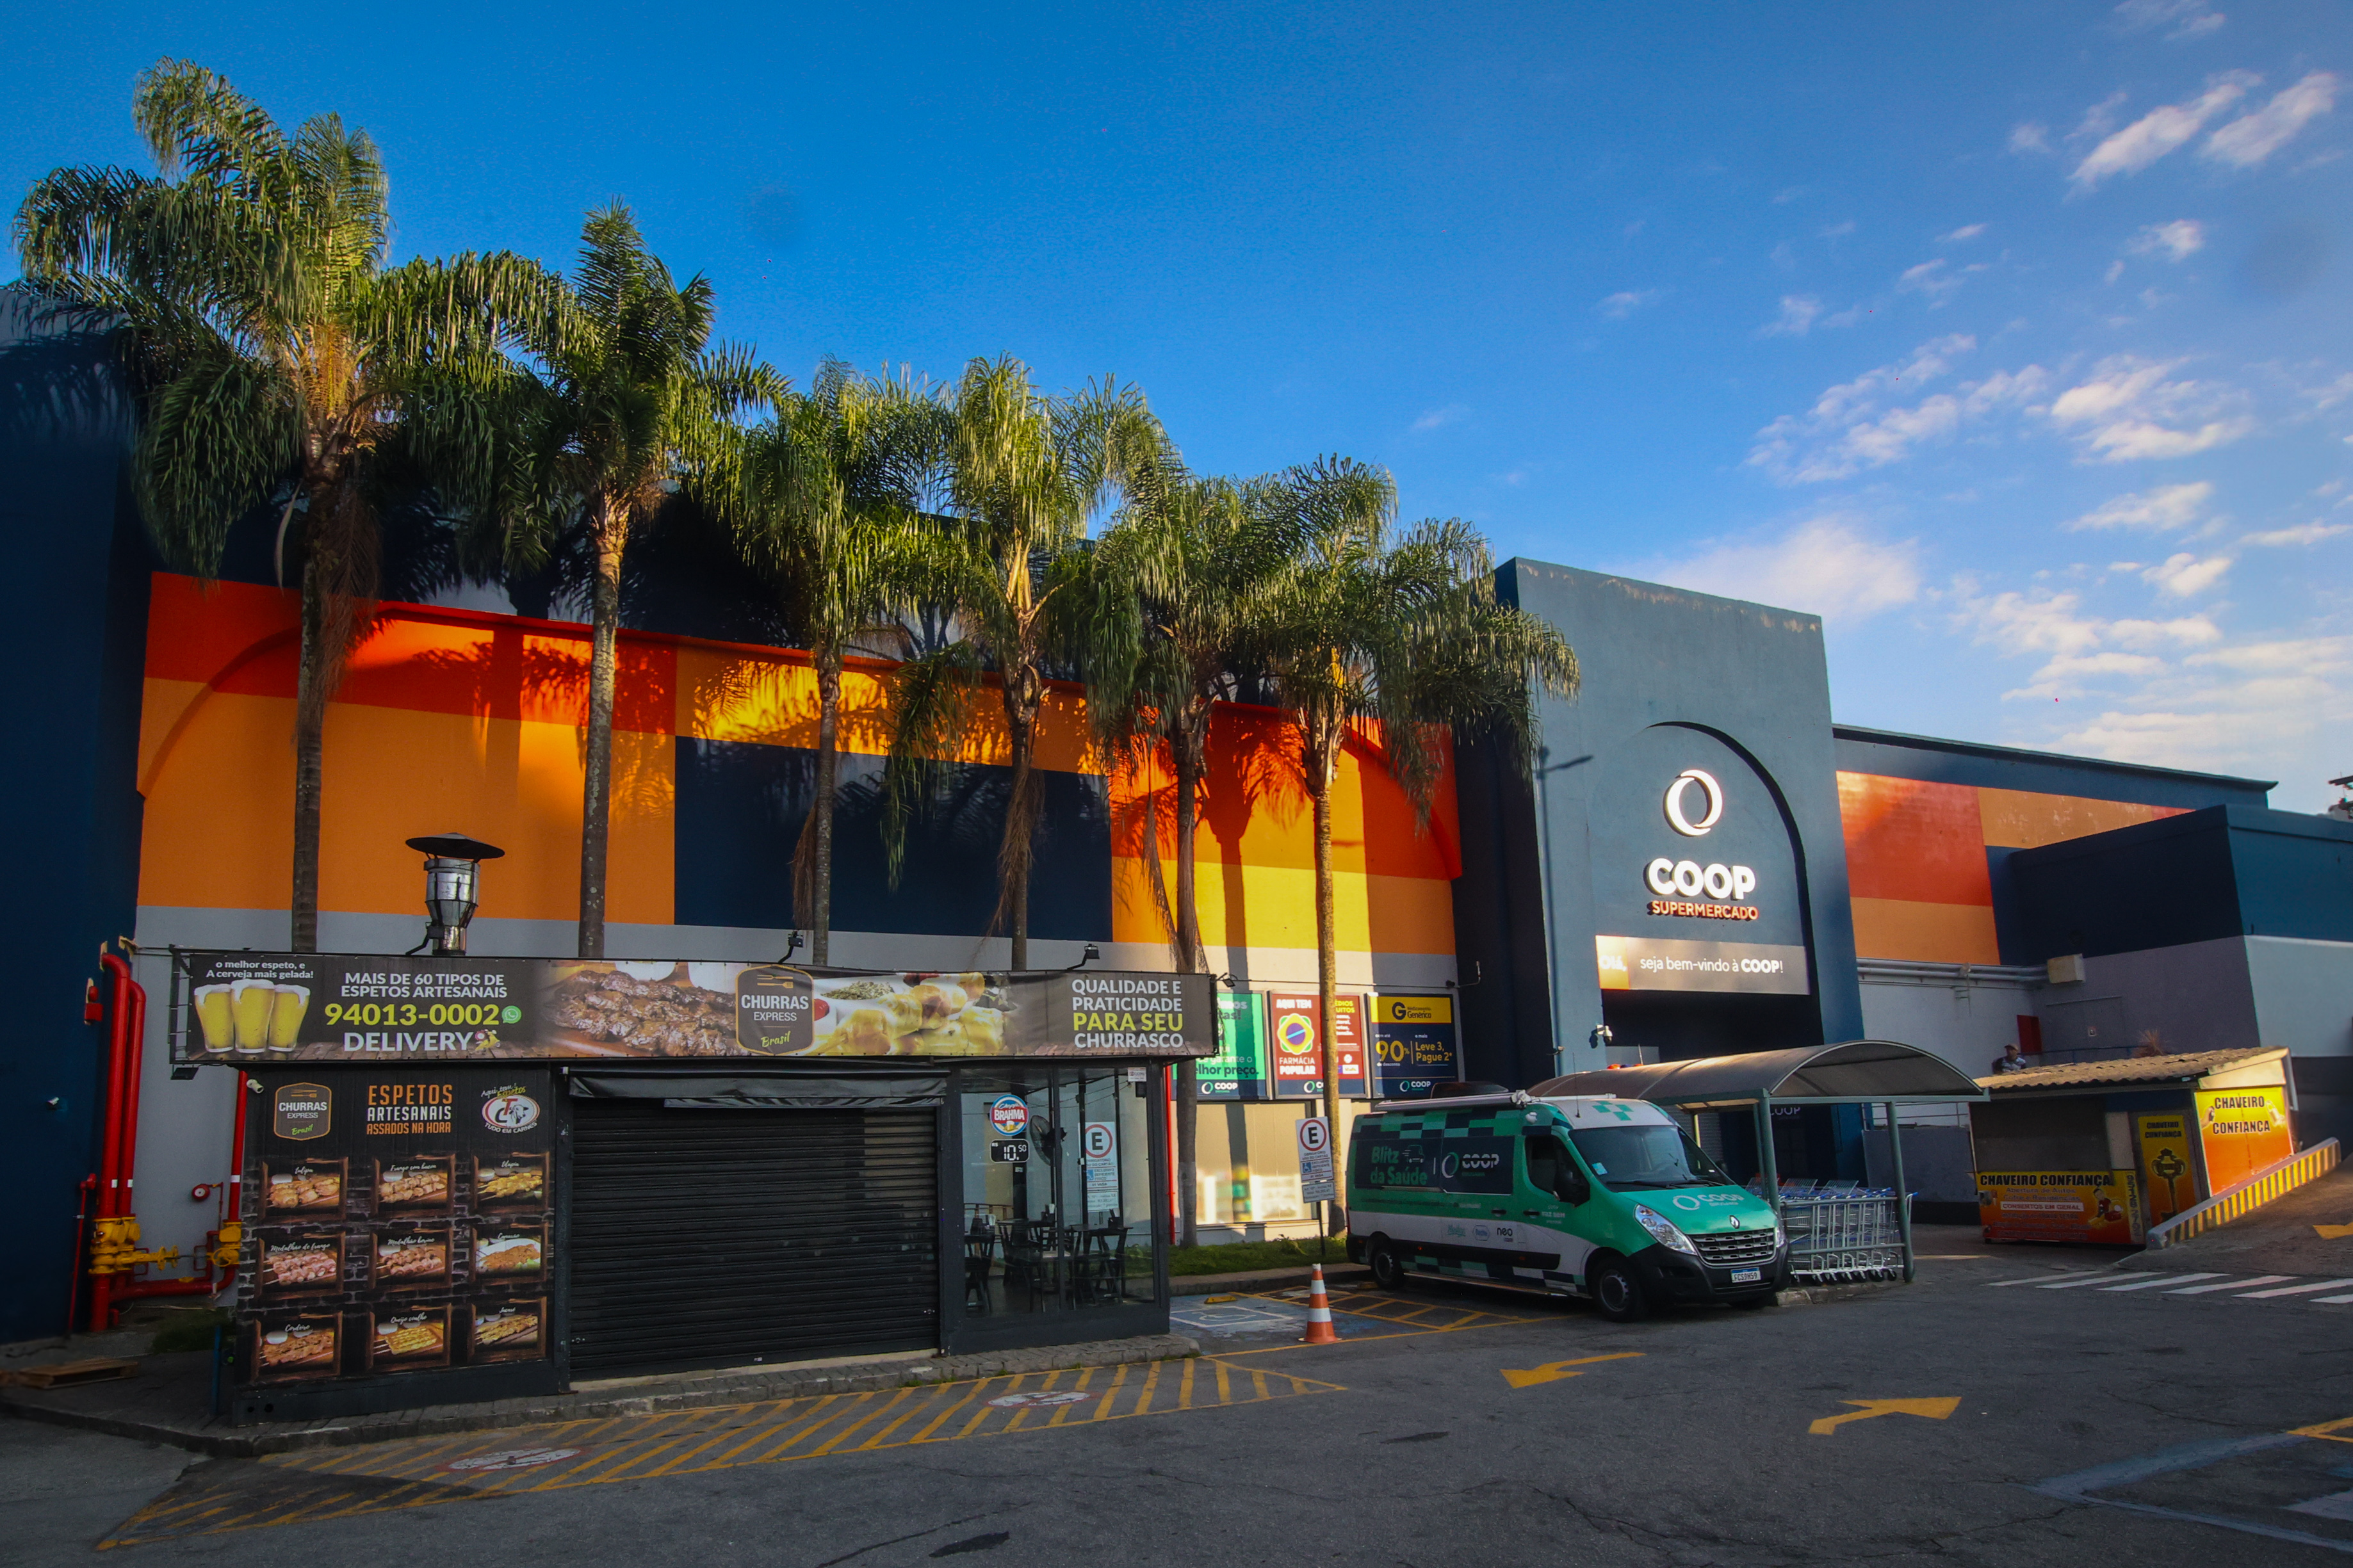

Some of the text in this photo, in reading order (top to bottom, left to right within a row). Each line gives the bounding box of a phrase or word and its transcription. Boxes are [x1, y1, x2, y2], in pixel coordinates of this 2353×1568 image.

[1647, 858, 1755, 900] COOP
[1650, 900, 1759, 920] SUPERMERCADO
[261, 962, 297, 971] espeto,
[1640, 956, 1664, 973] seja
[1666, 957, 1729, 972] bem-vindo
[1732, 958, 1739, 972] à
[1741, 958, 1783, 973] COOP!
[216, 970, 252, 980] cerveja
[254, 970, 277, 978] mais
[279, 970, 313, 980] gelada!
[345, 973, 505, 985] MAIS DE 60 TIPOS DE
[341, 985, 507, 998] ESPETOS ARTESANAIS
[1071, 979, 1182, 995] QUALIDADE E
[741, 994, 809, 1010] CHURRAS
[1072, 997, 1182, 1012] PRATICIDADE
[1276, 999, 1312, 1009] AQUI TEM
[325, 1003, 500, 1026] 94013-0002
[754, 1012, 797, 1021] EXPRESS
[1408, 1010, 1431, 1019] Genérico
[1073, 1012, 1183, 1031] PARA SEU
[344, 1031, 474, 1051] DELIVERY
[761, 1030, 791, 1047] Brasil
[1074, 1033, 1184, 1048] CHURRASCO
[1415, 1042, 1444, 1051] Leve 3,
[1279, 1056, 1315, 1064] FARMÁCIA
[1416, 1053, 1442, 1063] Pague
[1224, 1067, 1258, 1078] preço.
[1280, 1065, 1315, 1075] POPULAR
[368, 1084, 453, 1105] ESPETOS
[279, 1101, 327, 1111] CHURRAS
[2215, 1096, 2265, 1109] CHAVEIRO
[367, 1106, 452, 1122] ARTESANAIS
[994, 1110, 1025, 1120] BRAHMA
[291, 1124, 313, 1135] Brasil
[366, 1122, 451, 1135] ASSADOS NA HORA
[485, 1122, 501, 1133] TUDO
[513, 1121, 537, 1133] CARNES
[1091, 1132, 1103, 1150] E
[1308, 1127, 1319, 1144] E
[1371, 1146, 1399, 1163] Blitz
[1461, 1154, 1499, 1168] COOP
[1371, 1166, 1428, 1185] da Saúde
[1980, 1175, 2037, 1186] CHAVEIRO
[1697, 1193, 1745, 1202] COOP
[1497, 1227, 1513, 1236] neo
